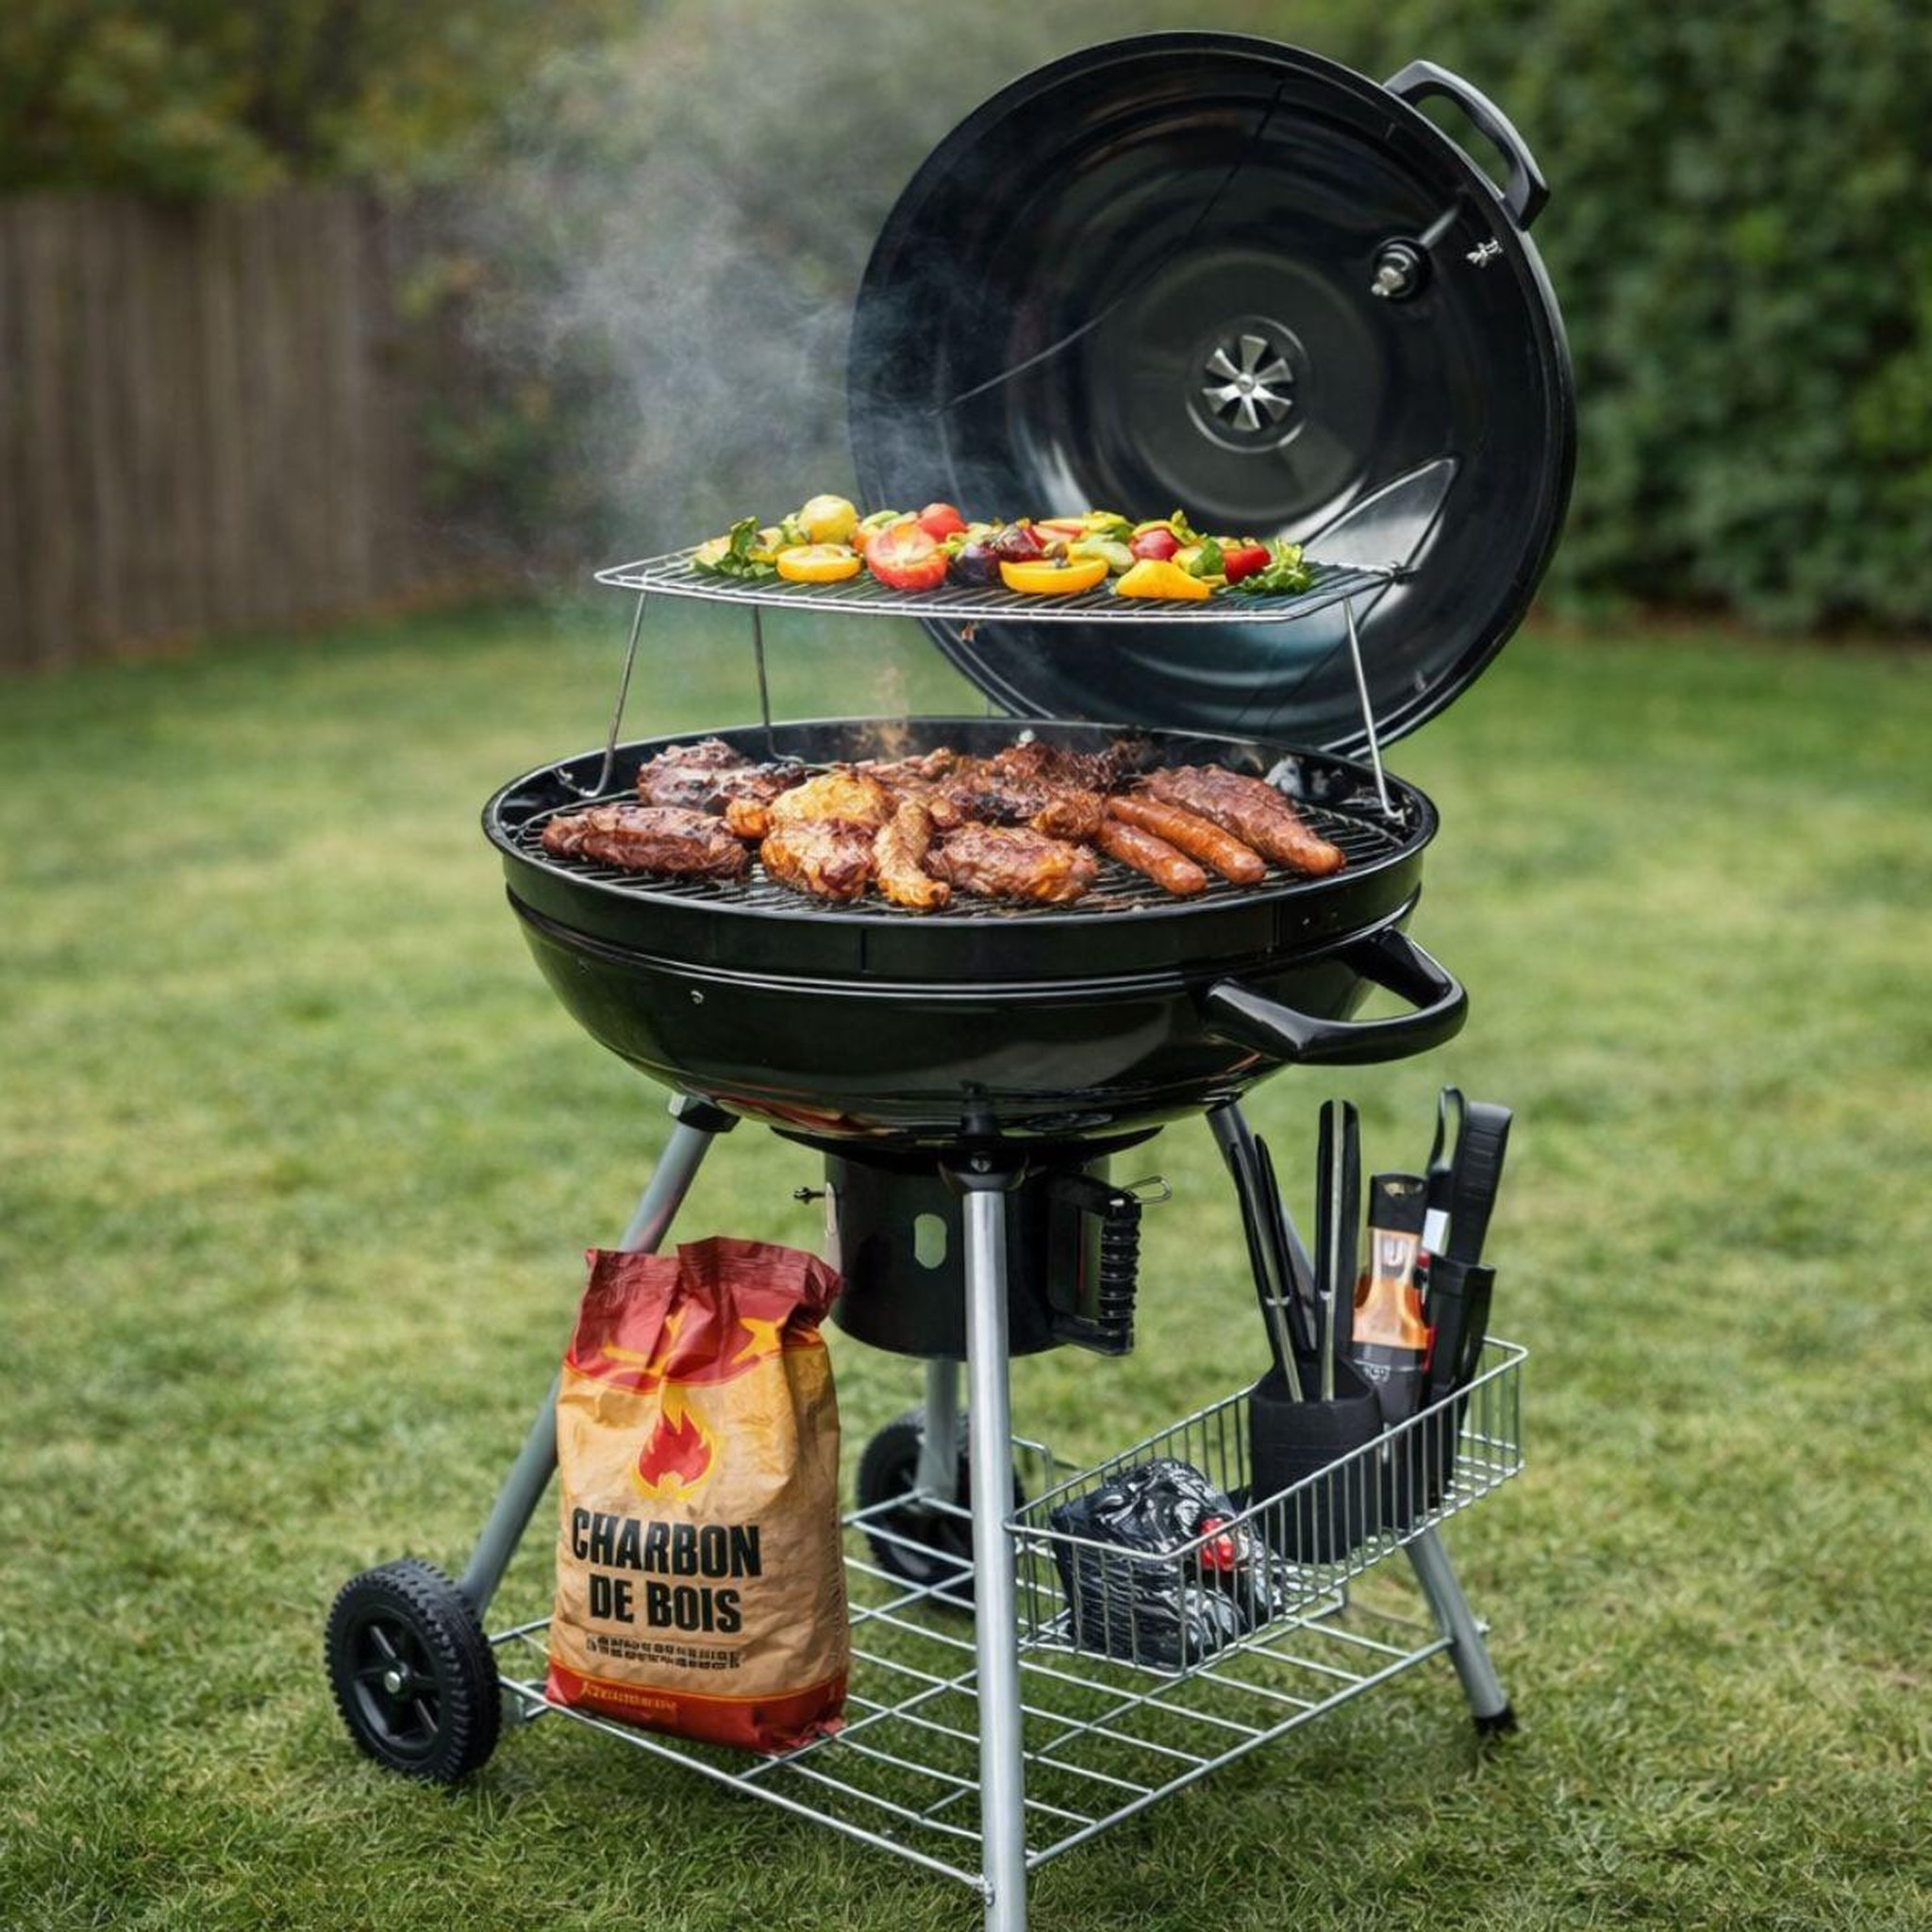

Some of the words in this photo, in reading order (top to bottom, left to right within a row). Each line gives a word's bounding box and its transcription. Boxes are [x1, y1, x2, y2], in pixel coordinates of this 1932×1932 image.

[572, 1507, 762, 1578] CHARBON
[589, 1573, 635, 1624] DE
[645, 1580, 742, 1633] BOIS
